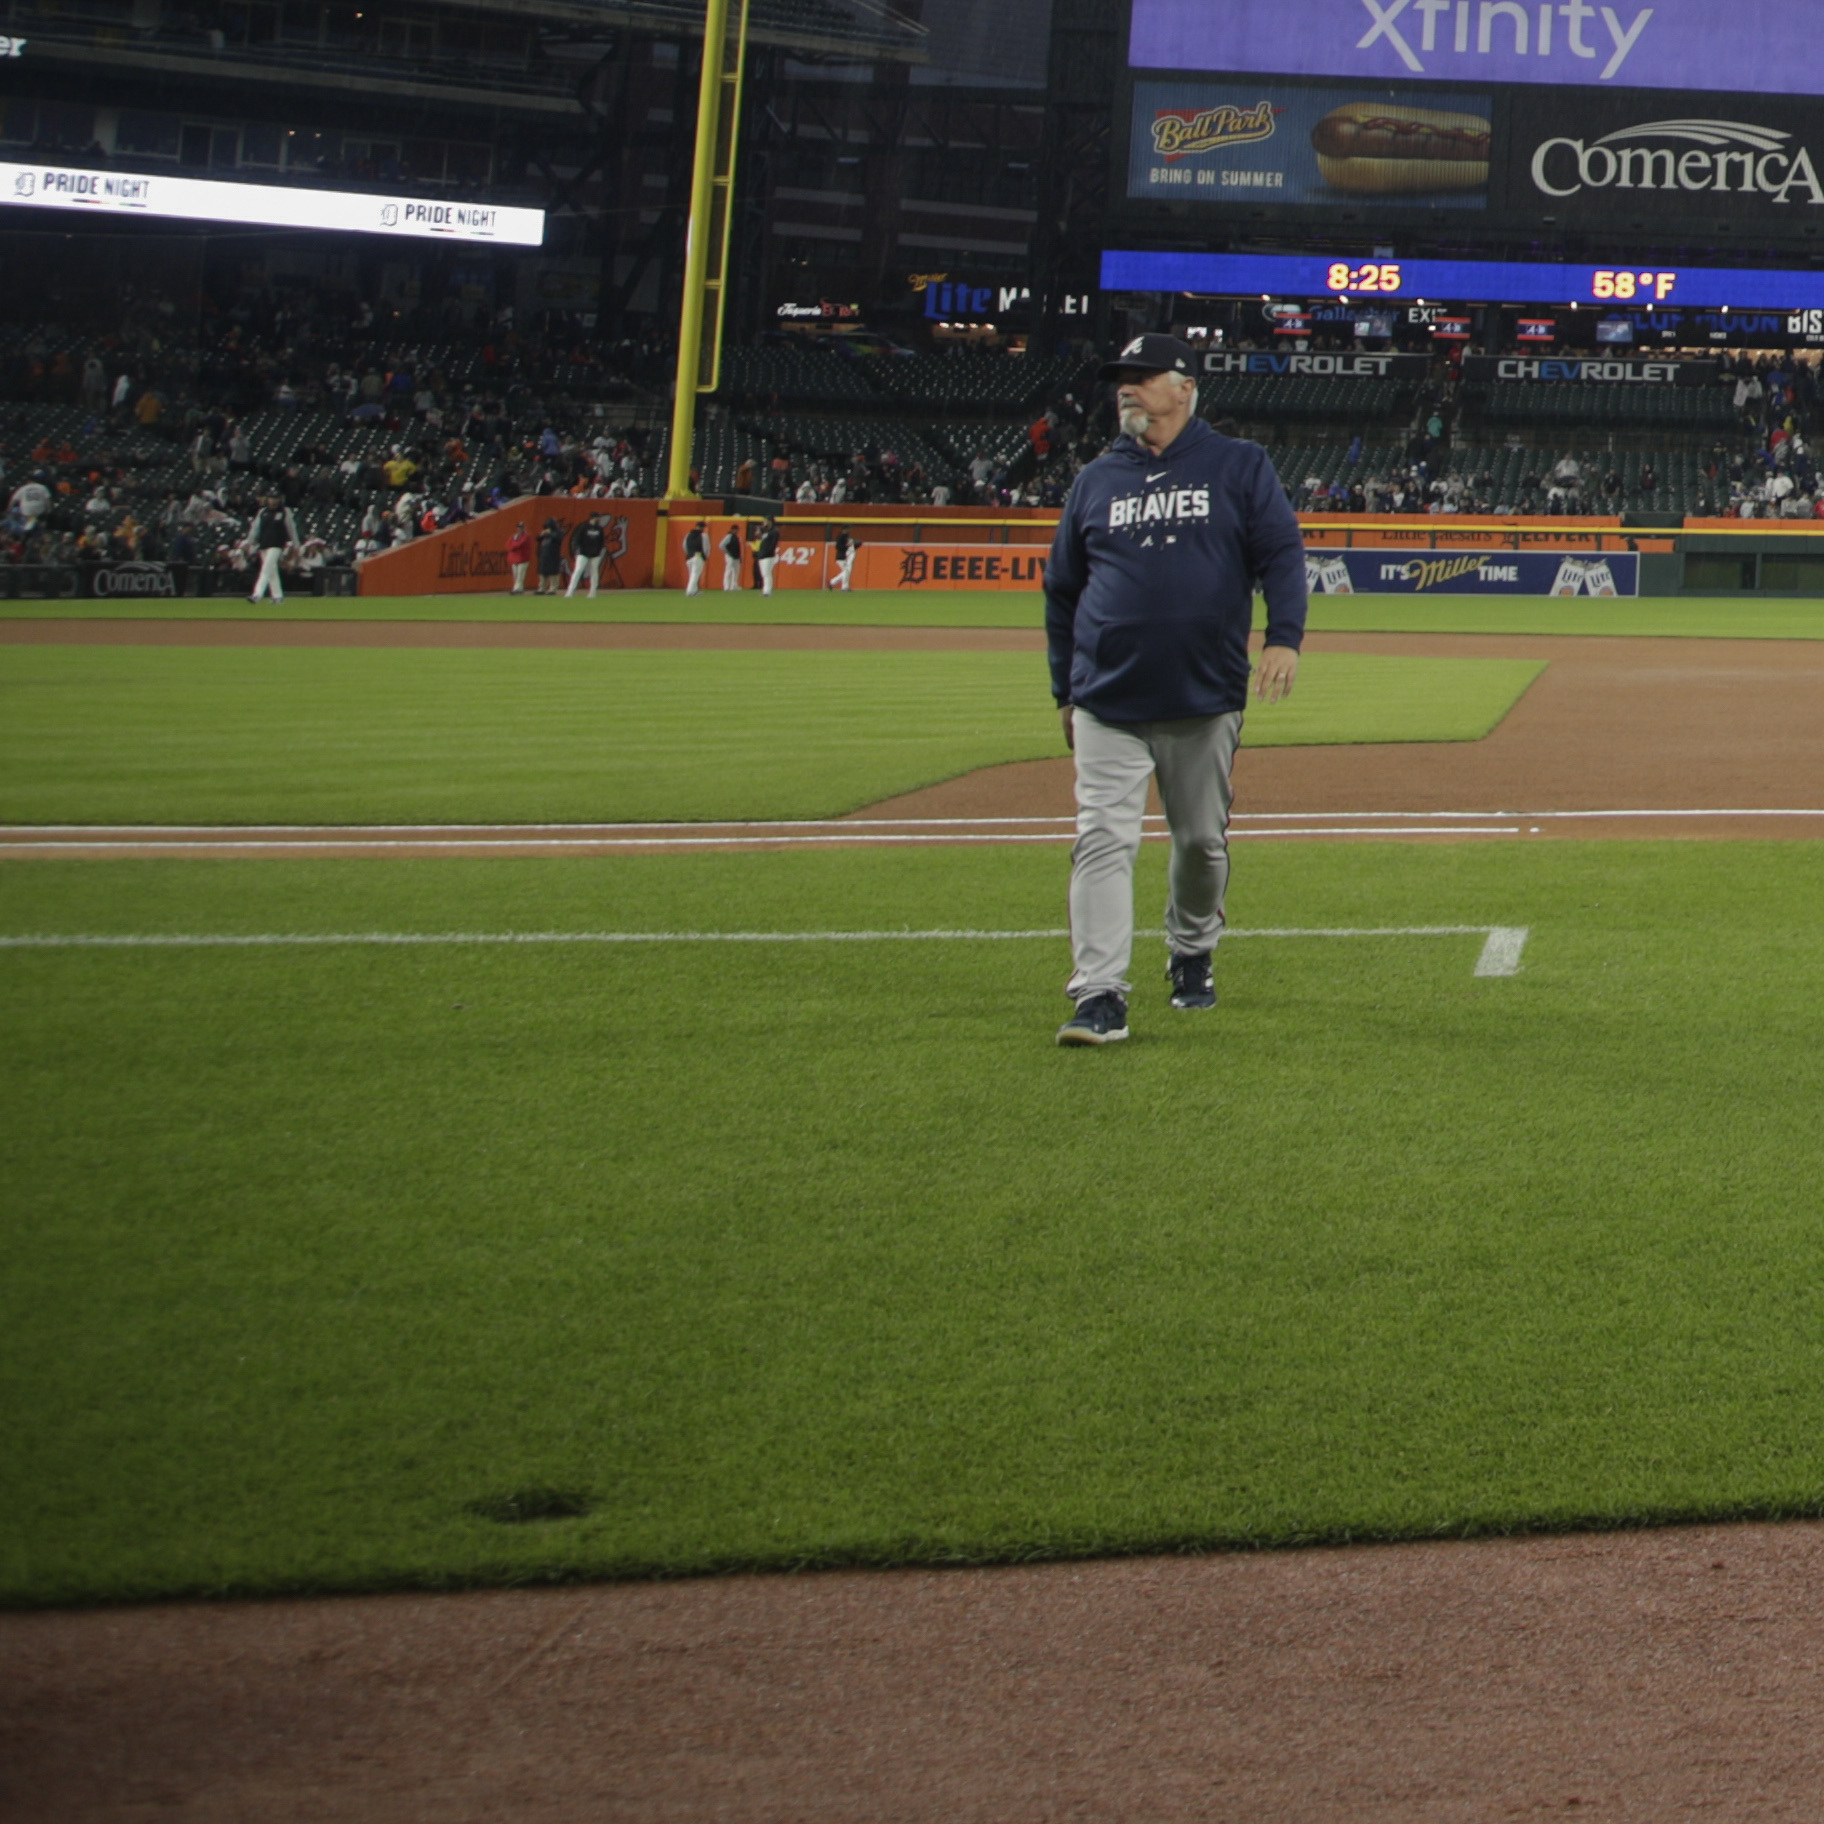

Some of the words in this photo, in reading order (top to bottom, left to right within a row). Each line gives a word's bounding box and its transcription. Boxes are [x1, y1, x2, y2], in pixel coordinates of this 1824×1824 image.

[43, 172, 98, 195] PRIDE
[104, 177, 150, 200] NIGHT
[1150, 166, 1192, 185] BRING
[1196, 168, 1216, 186] ON
[1221, 170, 1283, 188] SUMMER
[404, 203, 452, 225] PRIDE
[456, 207, 497, 228] NIGHT
[1327, 262, 1401, 292] 8:25
[1591, 270, 1676, 300] 58°F
[923, 281, 993, 320] Lite
[1204, 352, 1393, 377] CHEVROLET
[1497, 358, 1681, 382] CHEVROLET
[1108, 489, 1210, 528] BRAVES
[1380, 564, 1411, 581] IT'S
[1405, 554, 1494, 591] Miller
[1478, 565, 1519, 582] TIME
